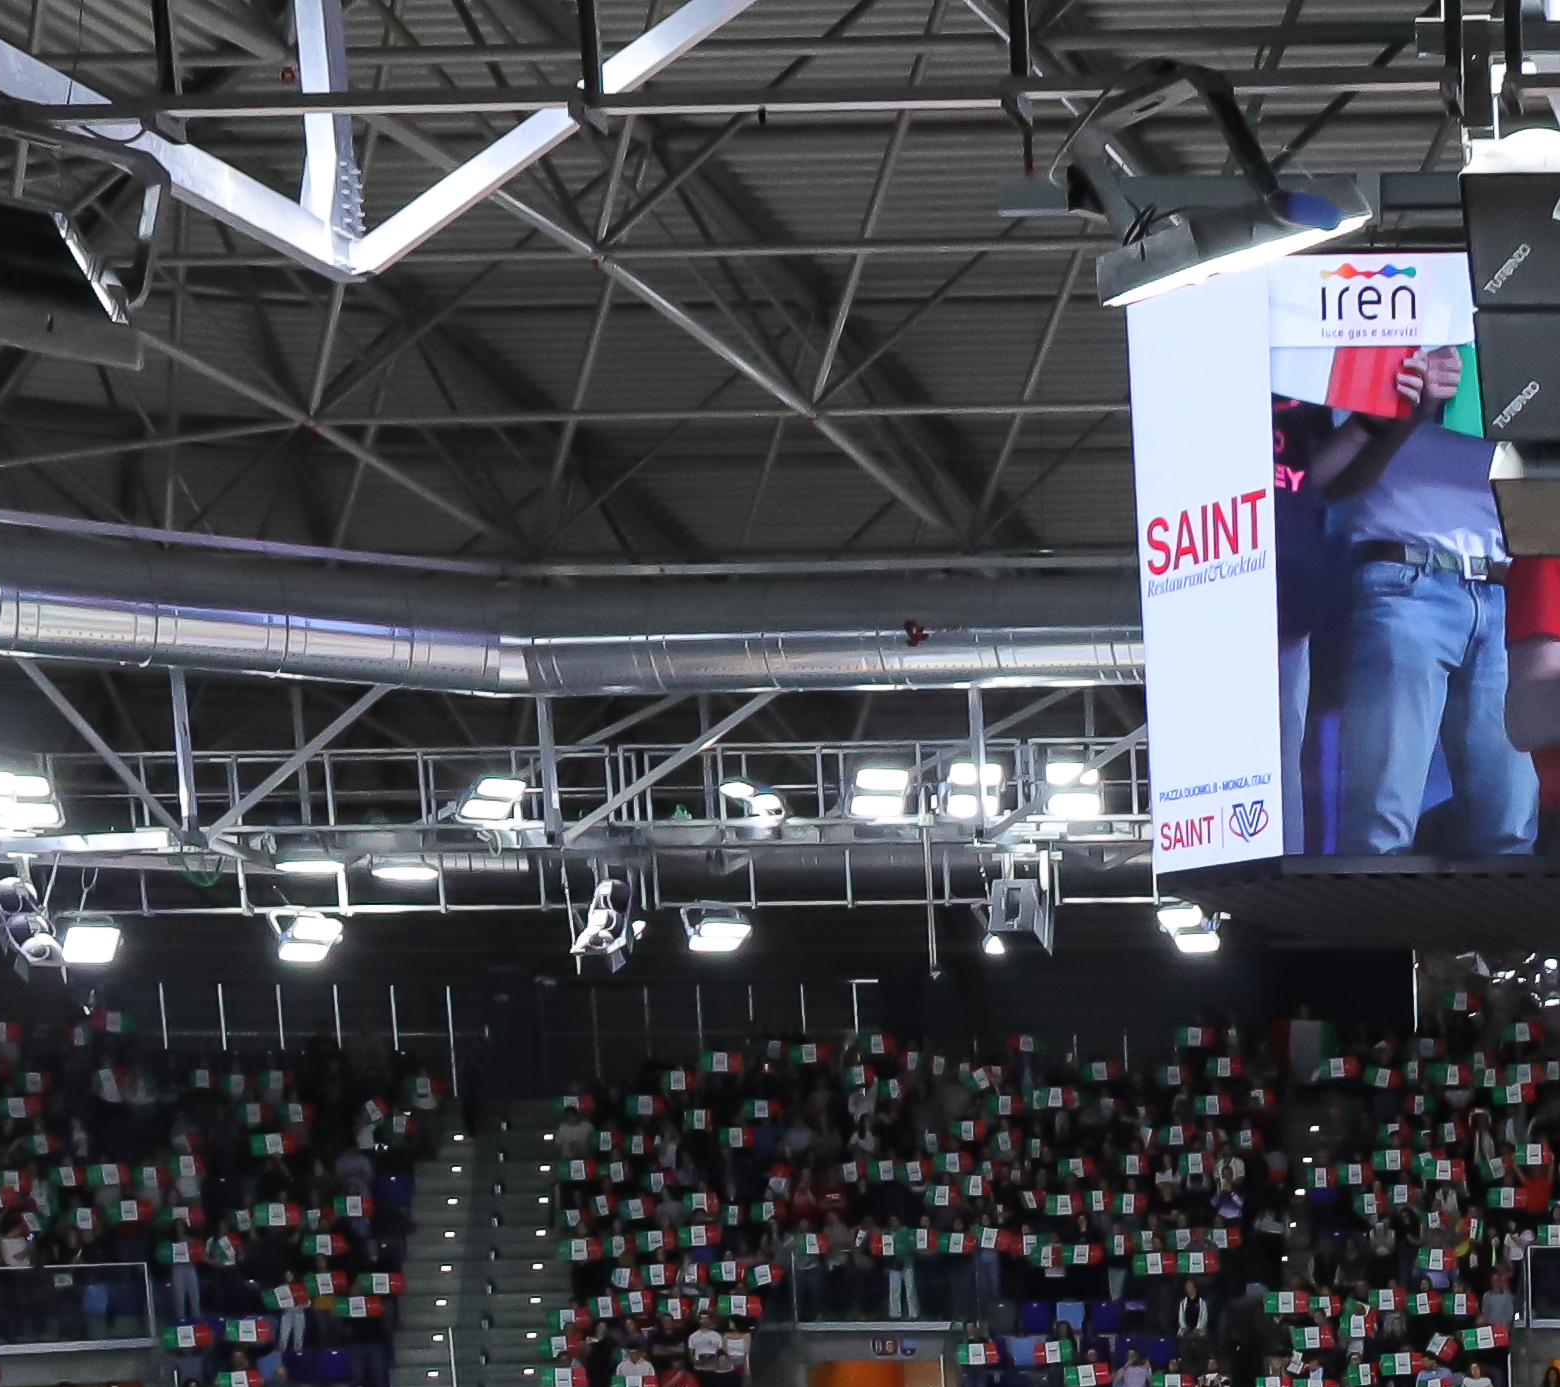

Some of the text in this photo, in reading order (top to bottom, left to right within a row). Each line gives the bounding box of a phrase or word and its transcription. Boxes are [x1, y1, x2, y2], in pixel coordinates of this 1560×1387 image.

[1320, 285, 1417, 321] iren
[1147, 488, 1267, 576] SAINT
[1160, 815, 1215, 851] SAINT
